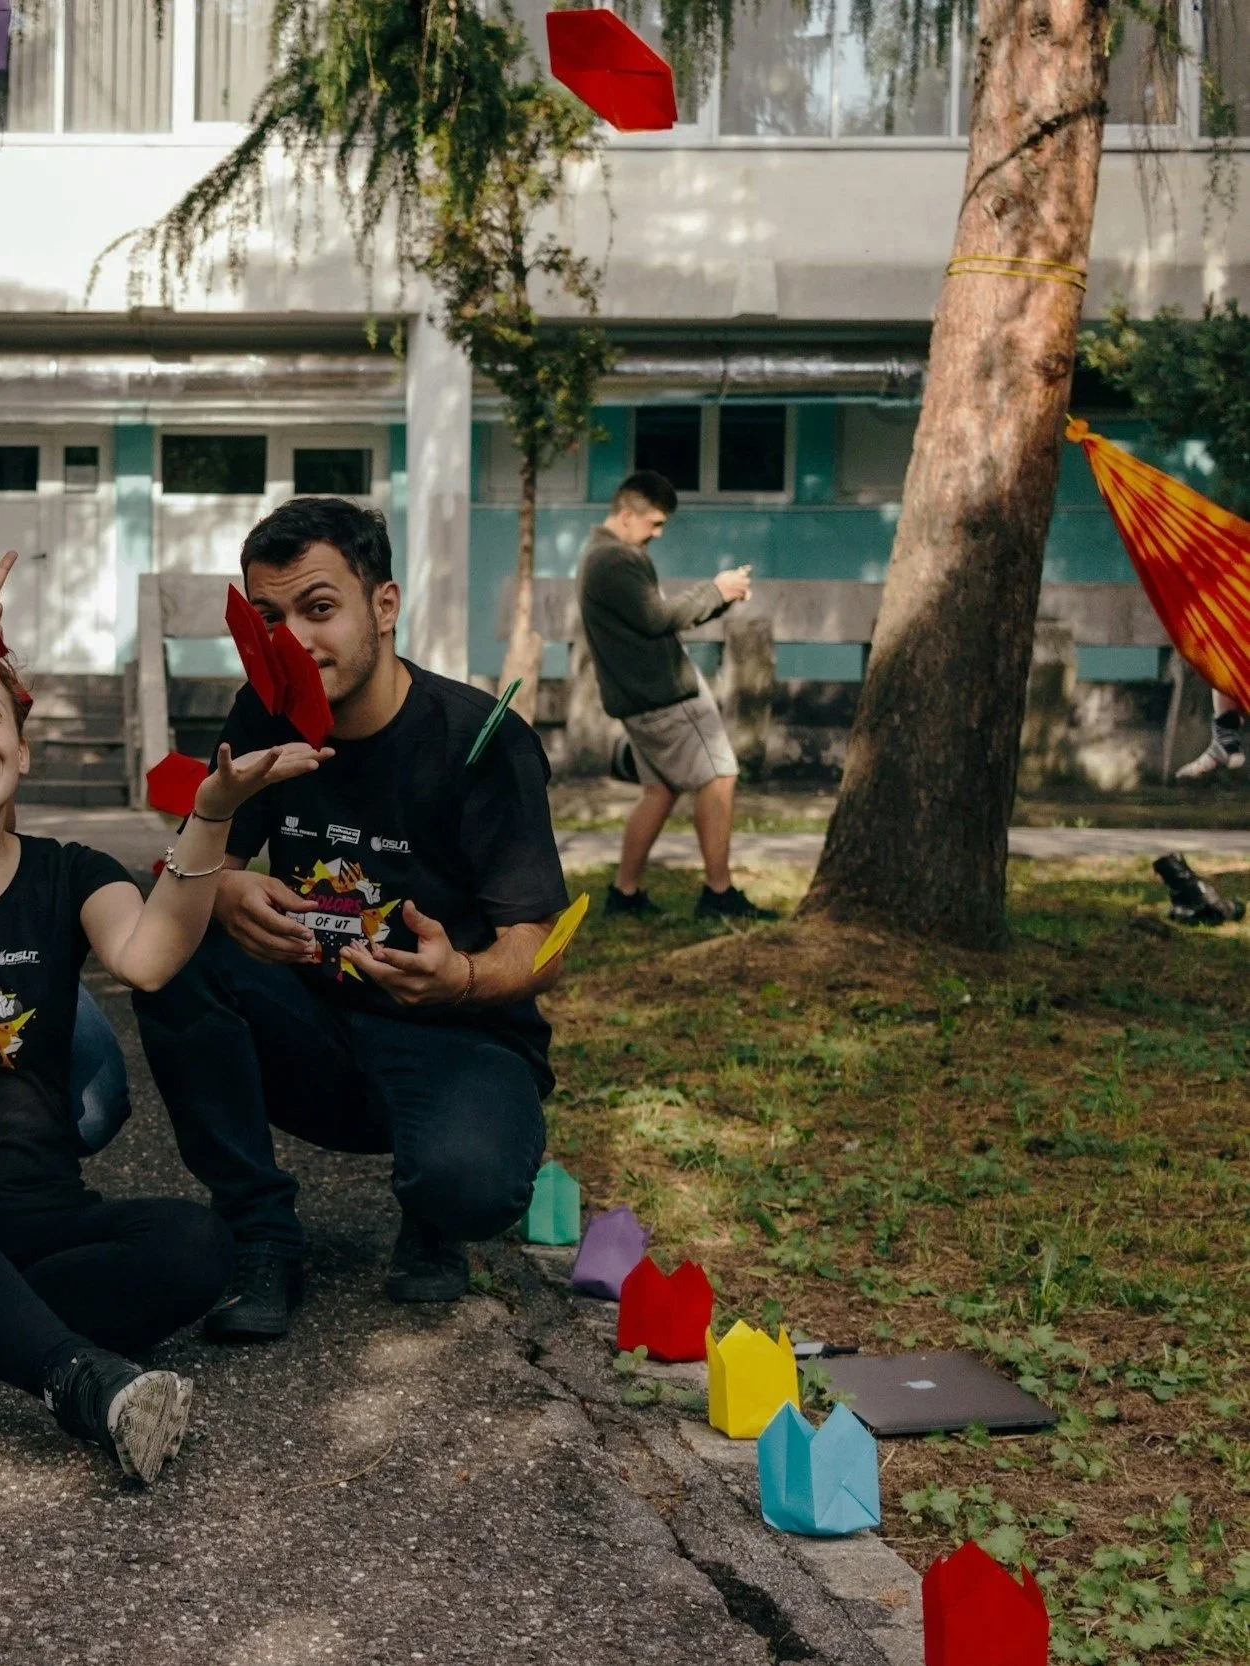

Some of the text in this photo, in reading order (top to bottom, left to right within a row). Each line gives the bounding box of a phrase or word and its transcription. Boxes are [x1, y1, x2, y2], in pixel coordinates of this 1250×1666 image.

[315, 916, 351, 930] OF UT
[5, 950, 39, 962] OSUT
